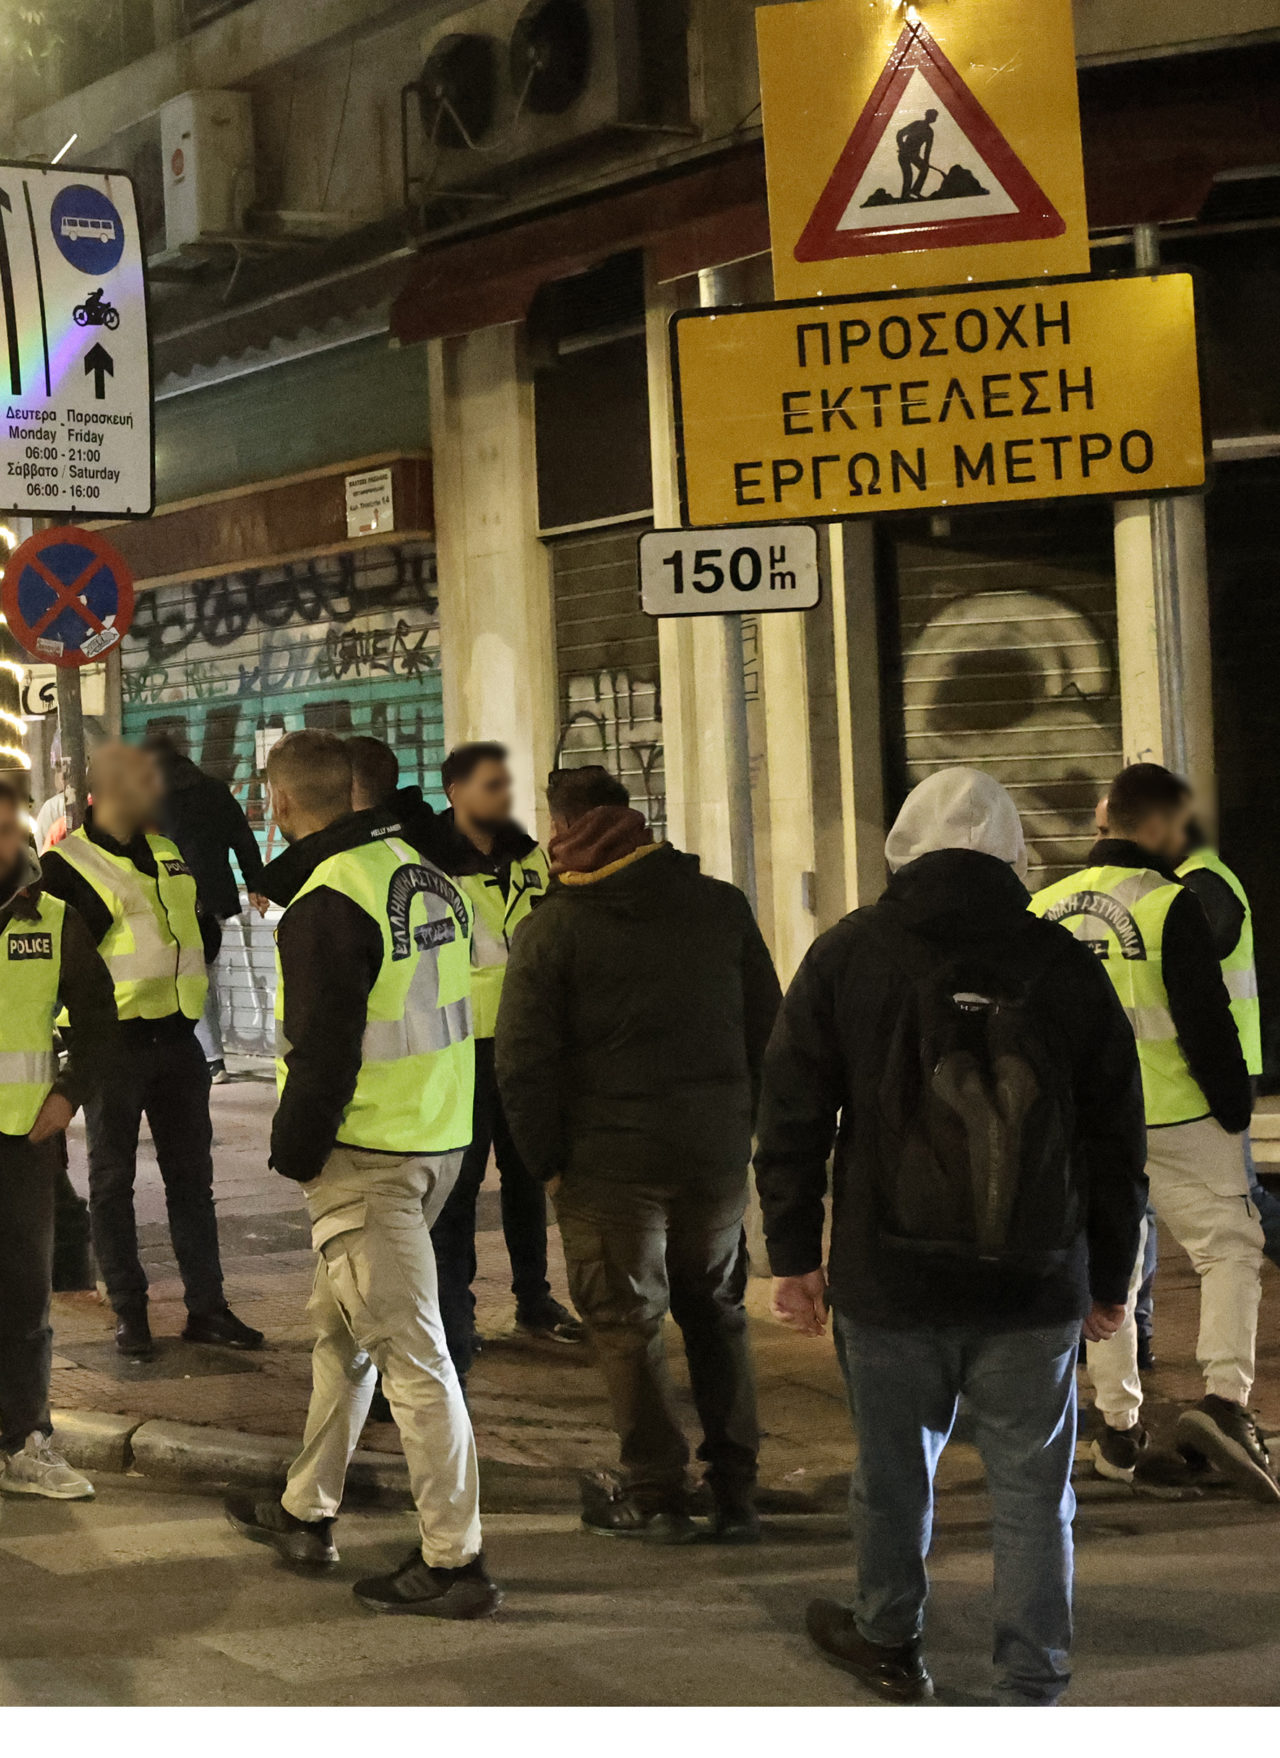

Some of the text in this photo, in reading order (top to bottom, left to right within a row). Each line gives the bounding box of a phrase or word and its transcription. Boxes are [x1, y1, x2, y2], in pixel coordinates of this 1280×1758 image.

[797, 301, 1070, 367] ΠΡΟΣΟΧΗ
[782, 366, 1094, 435] ΕΚΤΕΛΕΣΗ
[67, 409, 133, 429] Παρασκευή
[9, 426, 57, 444] Monday
[67, 429, 104, 446] Friday
[25, 446, 58, 460] 06:00
[68, 449, 101, 462] 21:00
[7, 461, 58, 479] Σάββατο
[69, 465, 120, 483] Saturday
[734, 429, 1154, 506] ΕΡΓΩΝ ΜΕΤΡΟ
[27, 483, 59, 496] 06:00
[70, 485, 100, 498] 16:00
[663, 547, 762, 594] 150
[769, 571, 796, 590] m
[1081, 894, 1140, 957] ΑΣΤΥΝΟΜΙΑ
[10, 938, 50, 954] POLICE
